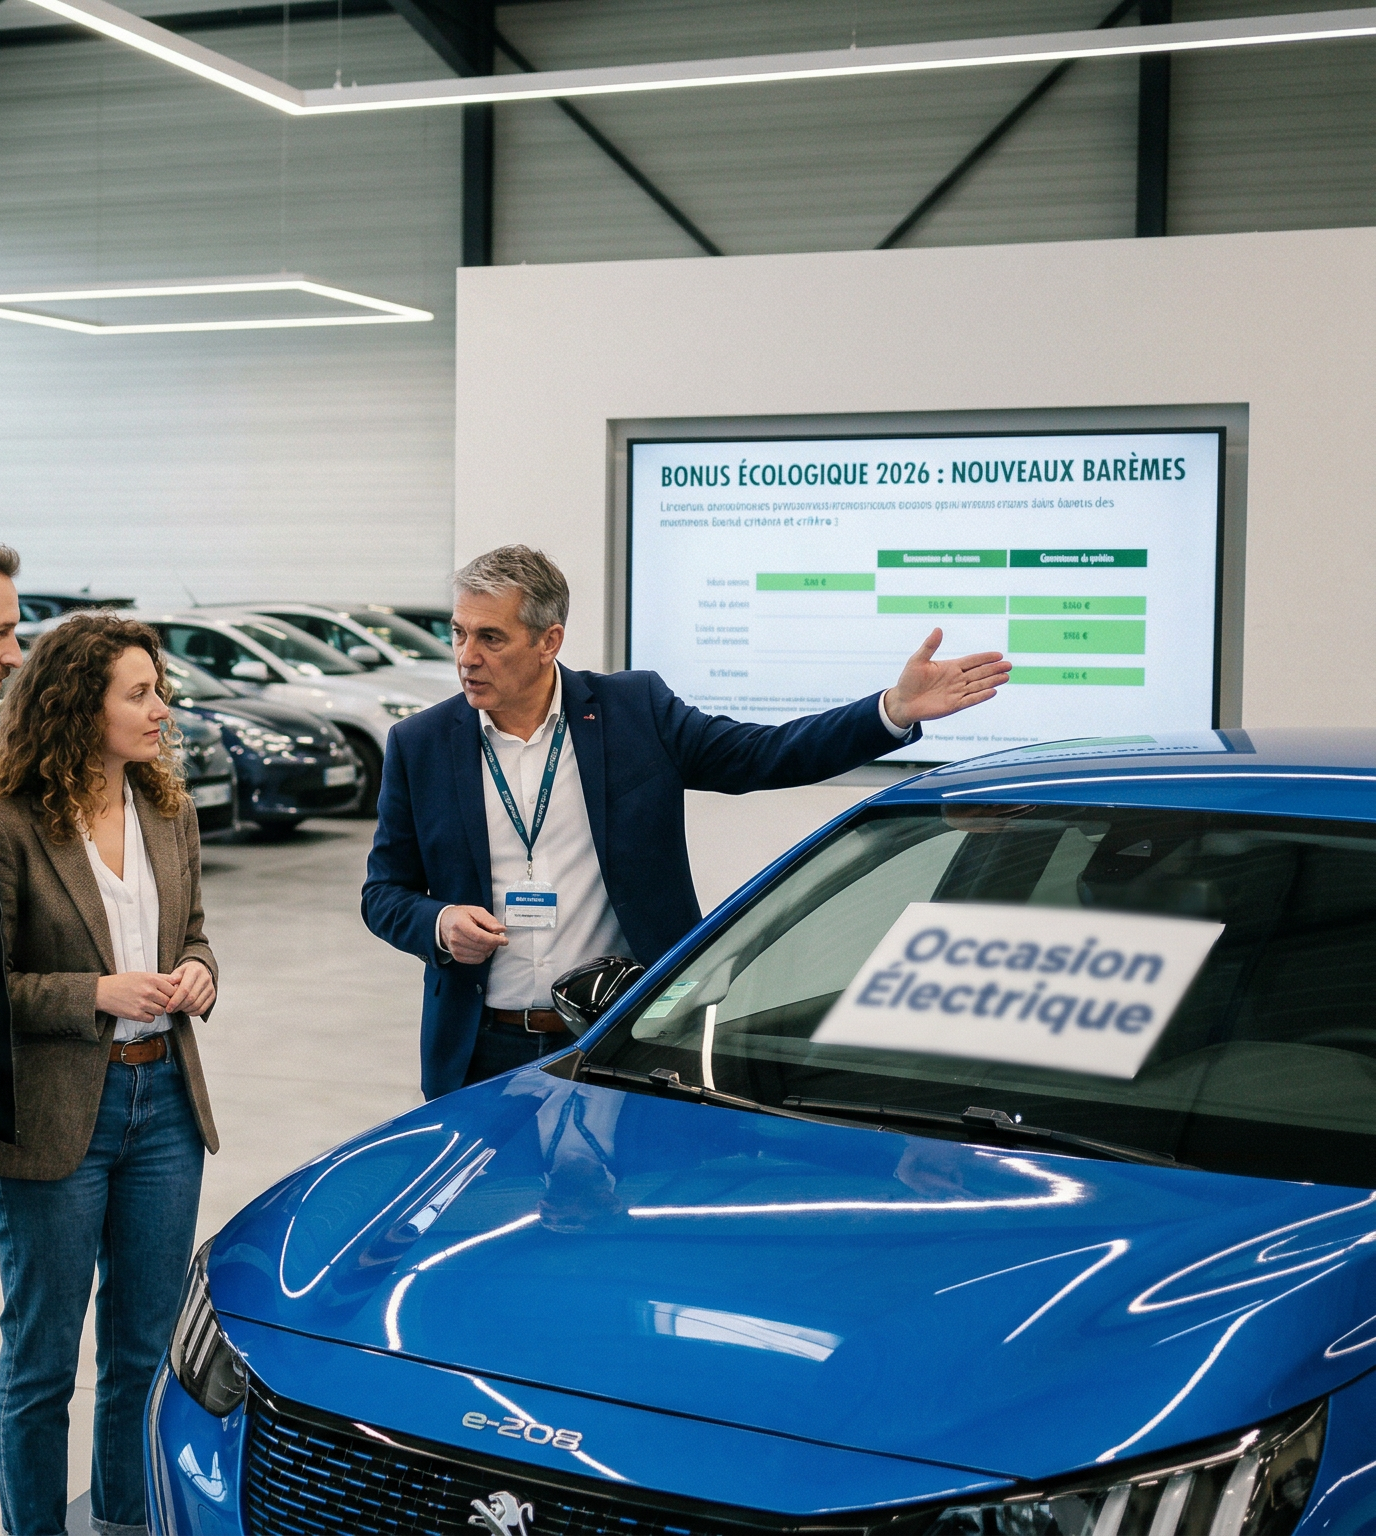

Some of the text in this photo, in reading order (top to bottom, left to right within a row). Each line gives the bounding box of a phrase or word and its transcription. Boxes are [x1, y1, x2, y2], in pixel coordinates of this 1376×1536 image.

[661, 465, 731, 487] BONUS
[738, 459, 869, 486] ÉCOLOGIQUE
[876, 462, 930, 485] 2026
[951, 460, 1075, 484] NOUVEAUX
[1083, 452, 1186, 482] BARÈMES
[904, 927, 1164, 984] Occasion
[856, 962, 1154, 1034] Électrique
[462, 1411, 584, 1451] e-208
